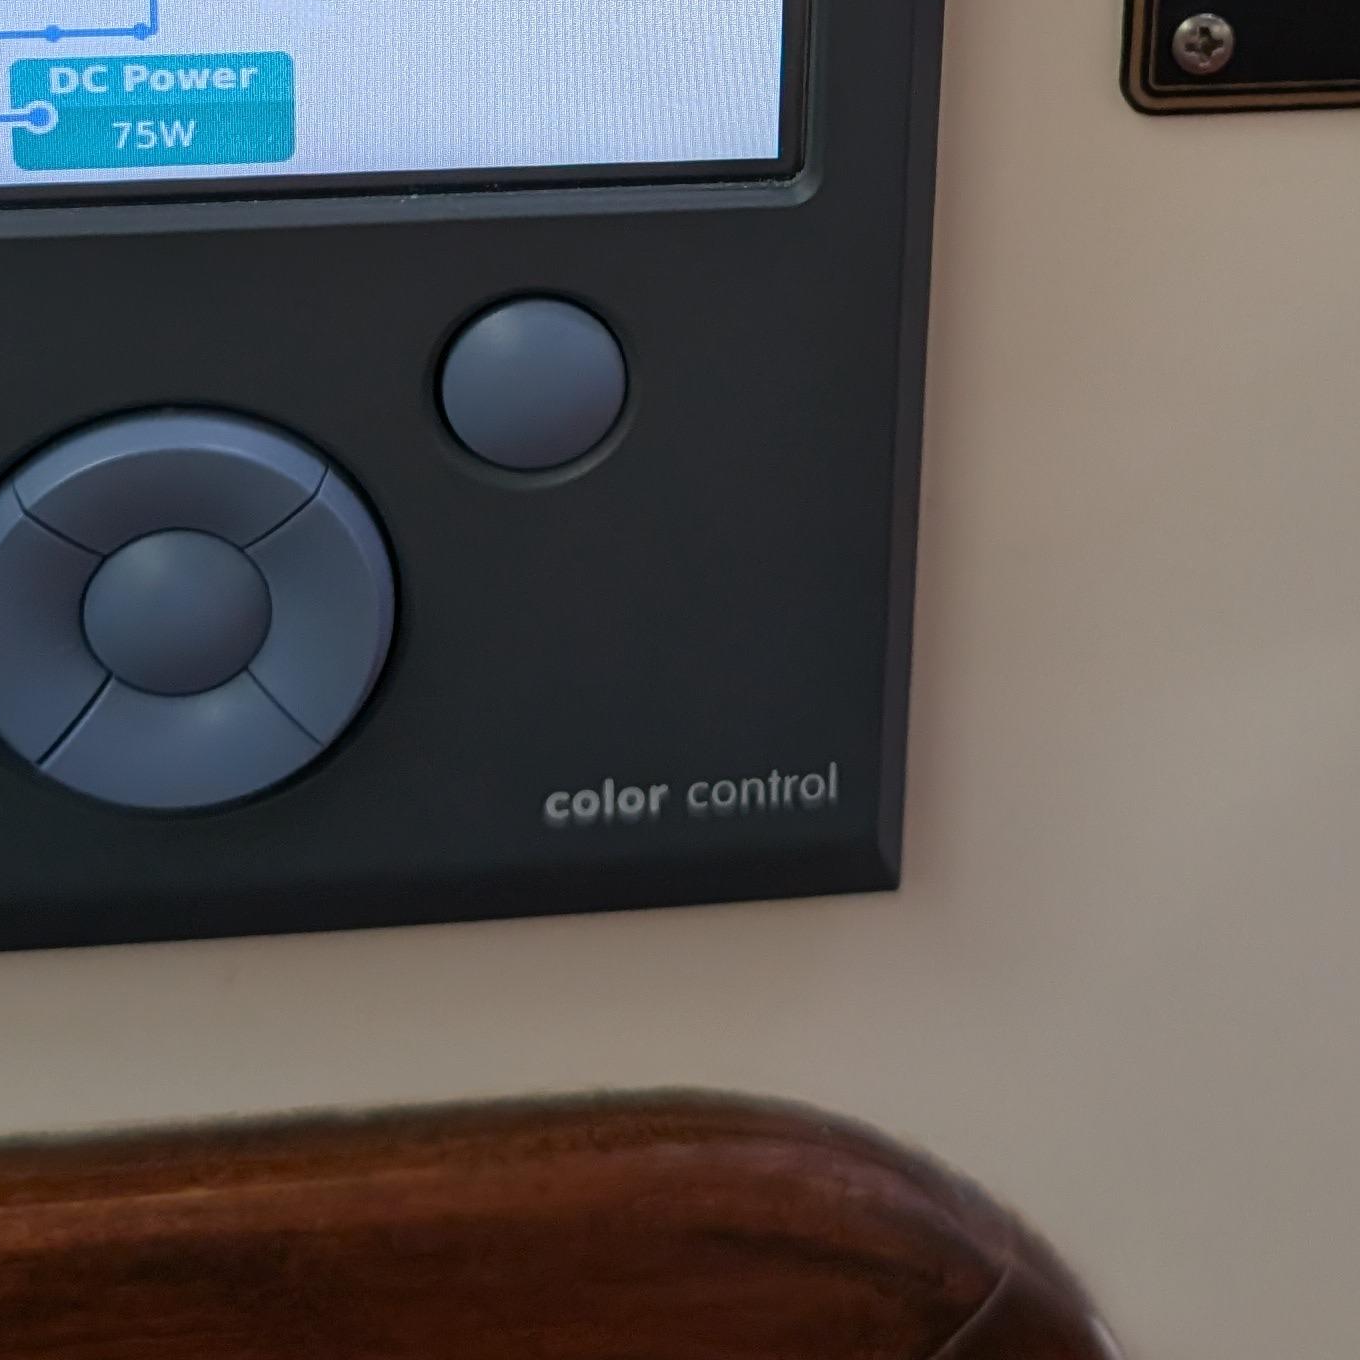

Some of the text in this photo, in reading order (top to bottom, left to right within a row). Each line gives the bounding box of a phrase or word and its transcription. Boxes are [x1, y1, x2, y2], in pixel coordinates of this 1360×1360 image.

[49, 62, 259, 95] DC Power
[112, 121, 197, 151] 75W
[544, 760, 838, 820] color control
